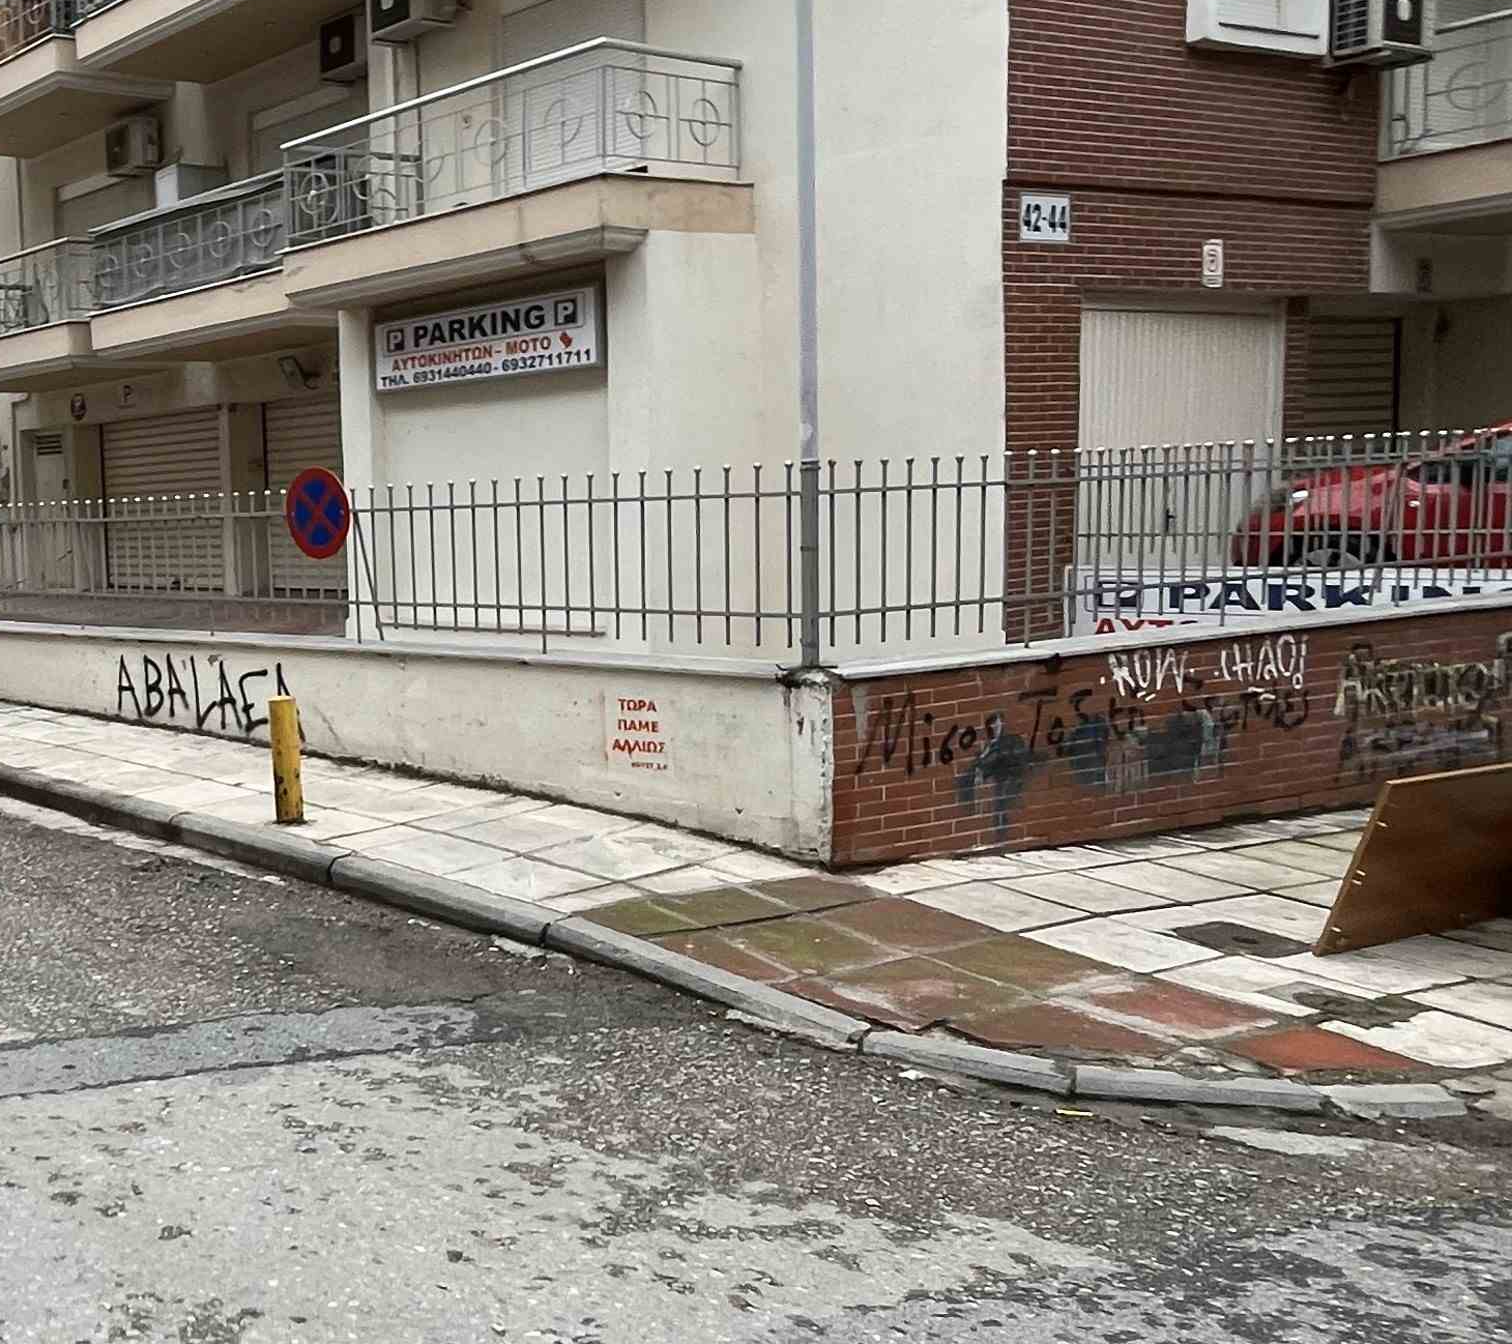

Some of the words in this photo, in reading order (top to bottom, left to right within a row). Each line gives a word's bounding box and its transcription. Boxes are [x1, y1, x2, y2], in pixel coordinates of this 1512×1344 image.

[1022, 203, 1067, 233] 42-44
[413, 305, 545, 347] PARKING
[391, 346, 492, 373] ΑΥΤΟΚΙΝΗΤΩΝ
[502, 349, 591, 372] 6932711711
[618, 698, 657, 712] ΤΩΡΑ
[617, 718, 660, 733] ΠΑΜΕ
